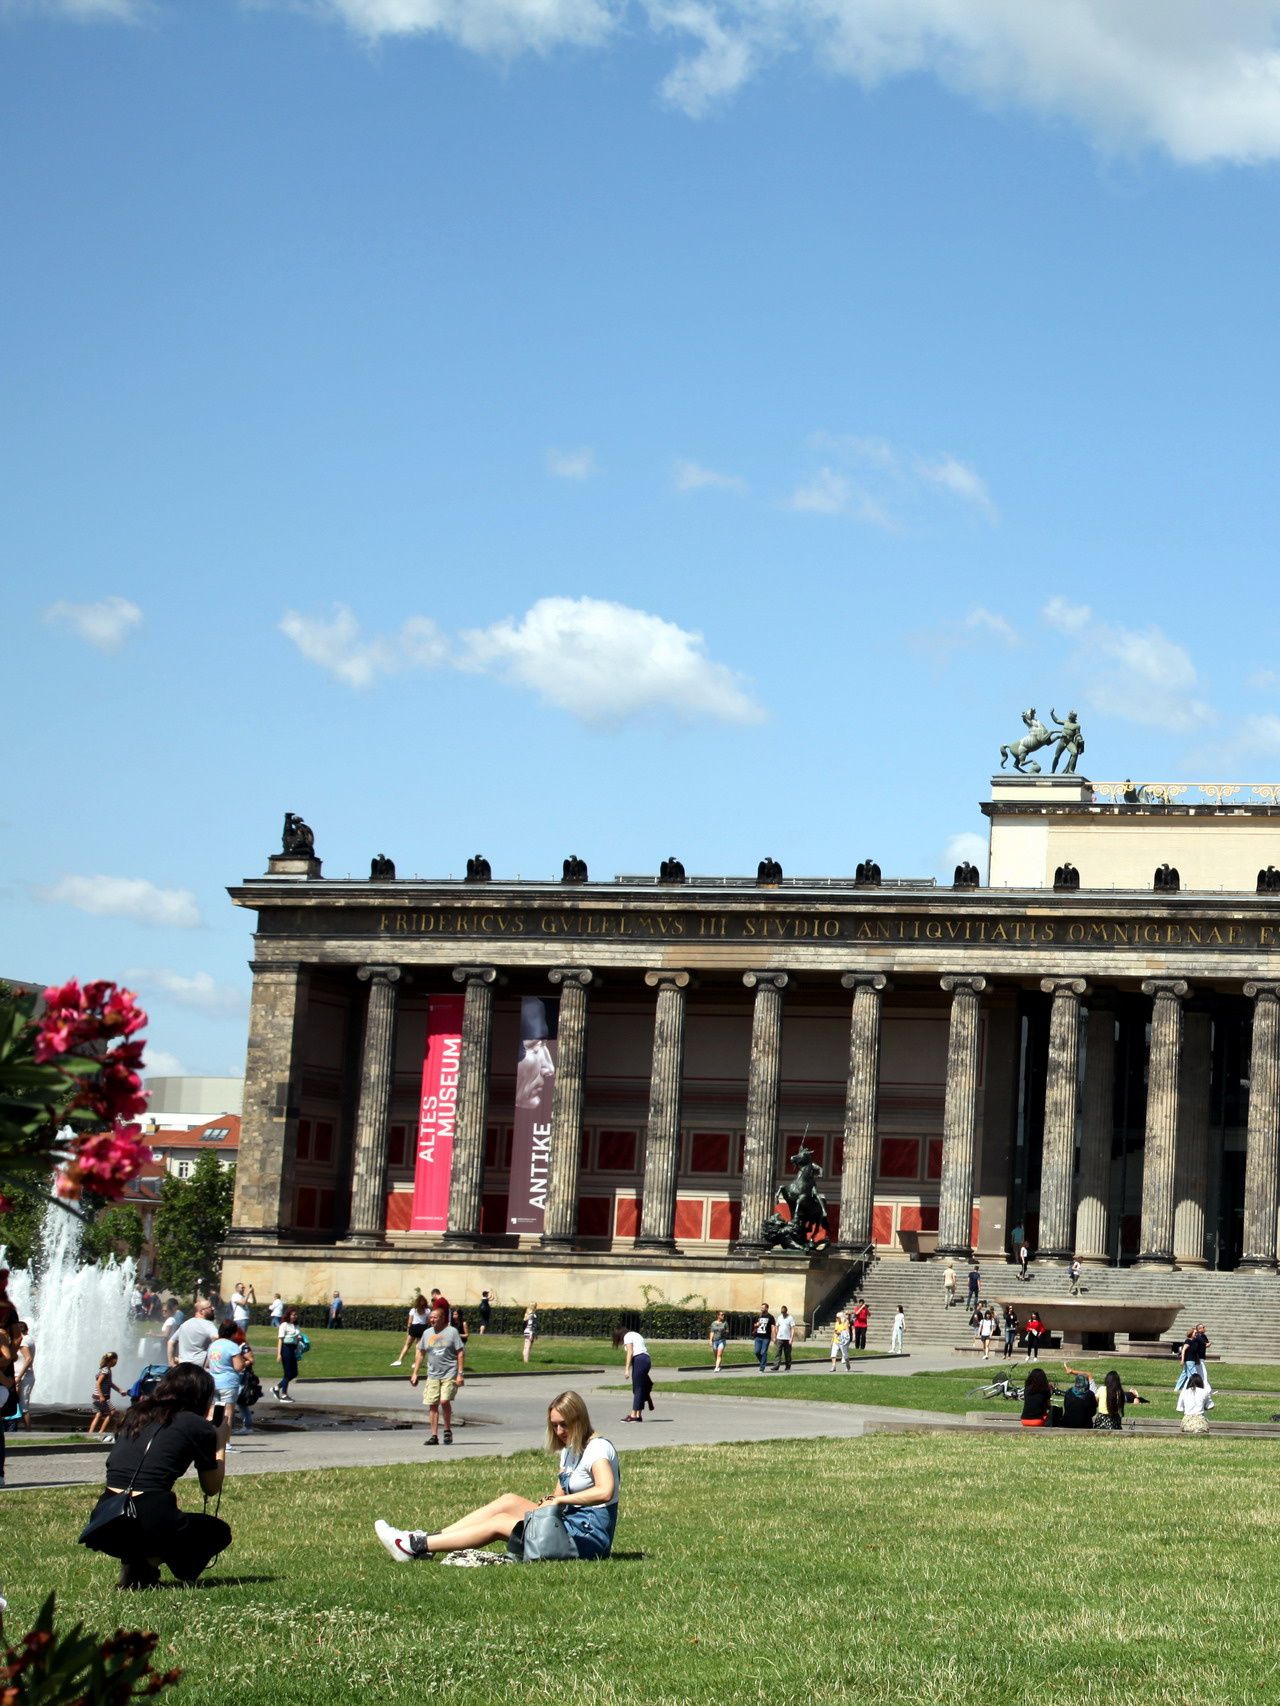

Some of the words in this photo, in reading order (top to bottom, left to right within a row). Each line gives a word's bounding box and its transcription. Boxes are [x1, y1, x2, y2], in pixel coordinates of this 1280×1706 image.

[379, 913, 524, 934] FRIDERICVS
[541, 915, 685, 936] GVILELMVS
[700, 917, 728, 936] III
[743, 918, 840, 938] STVDIO
[856, 920, 1054, 941] ANTIQVITATIS
[1068, 923, 1245, 944] OMNIGENAE
[437, 1038, 462, 1137] MUSEUM
[418, 1095, 438, 1163] ALTES
[528, 1122, 552, 1210] ANTIKE
